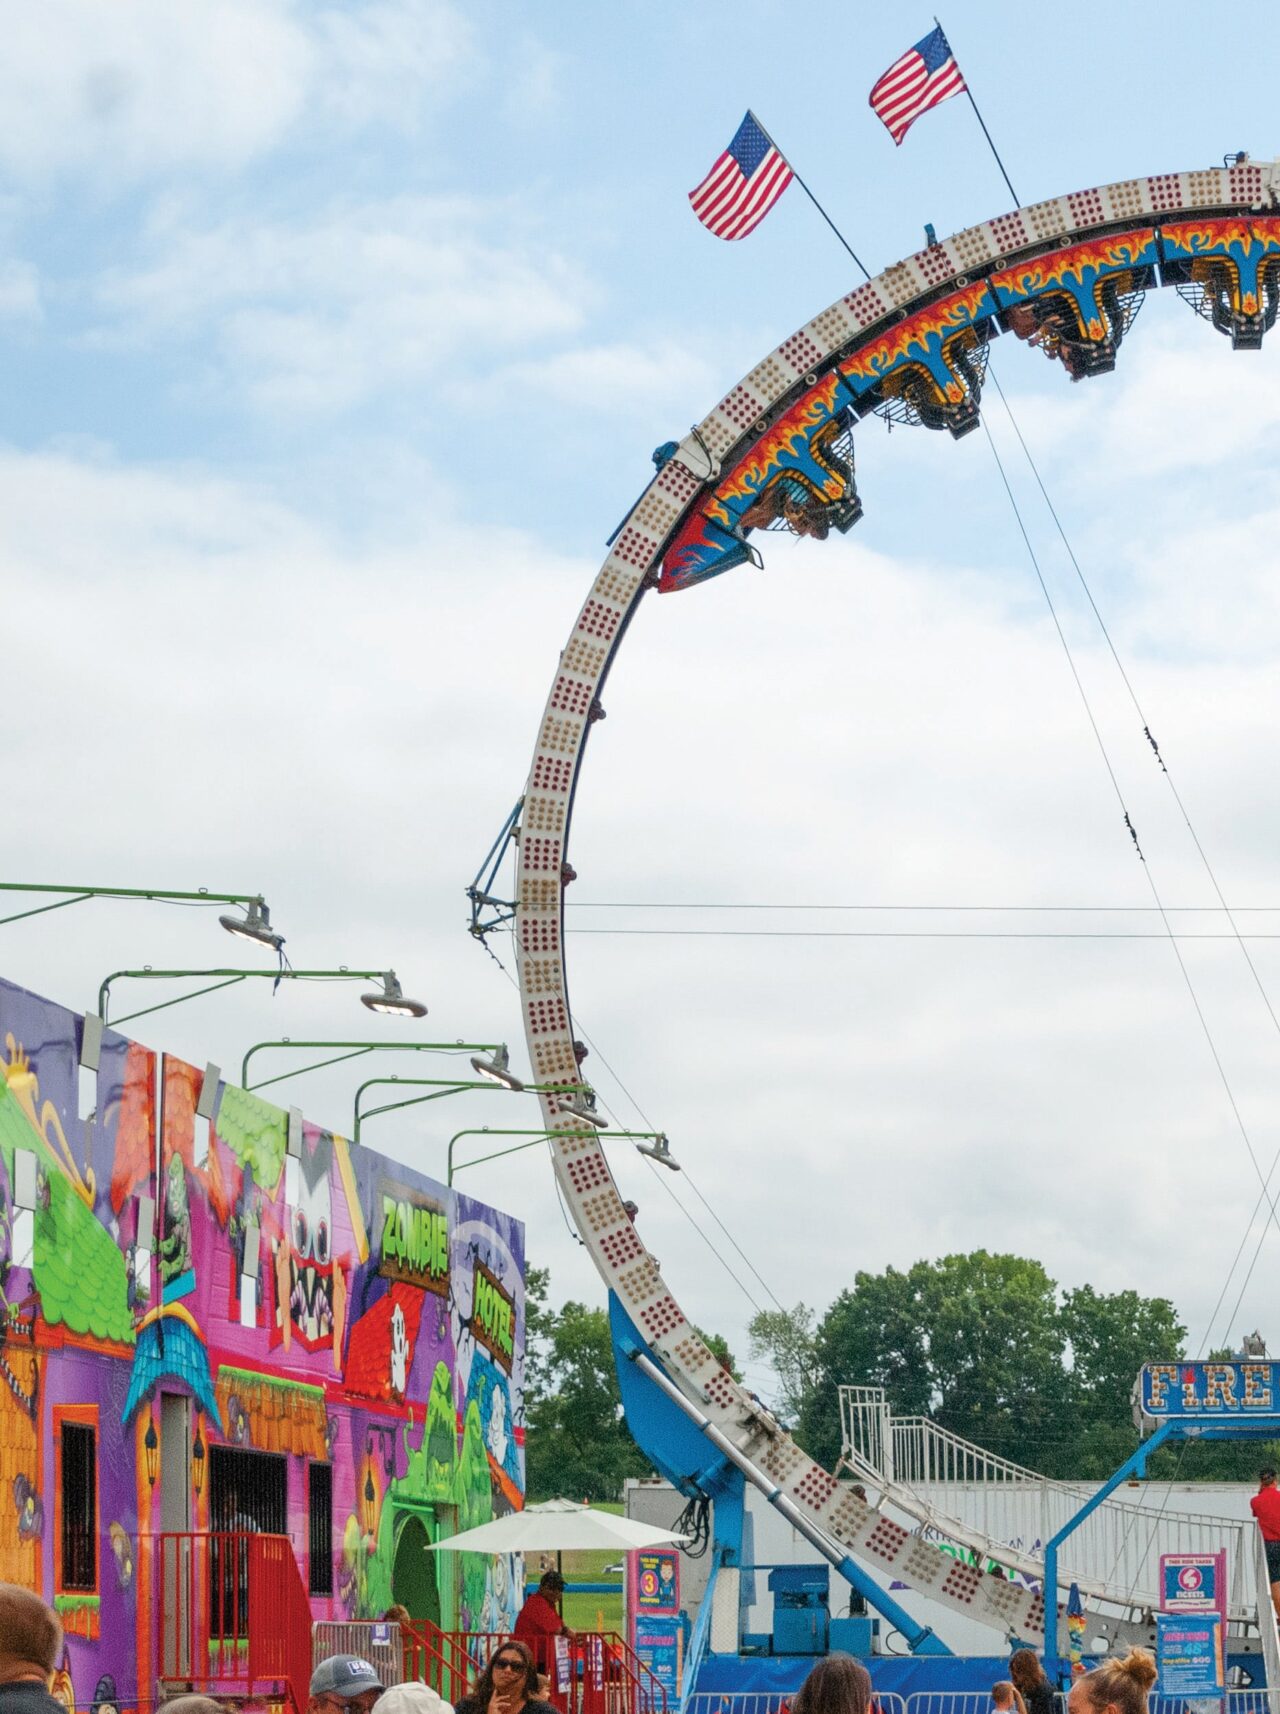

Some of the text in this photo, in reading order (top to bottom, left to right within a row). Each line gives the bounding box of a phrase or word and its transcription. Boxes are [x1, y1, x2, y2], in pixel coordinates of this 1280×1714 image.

[383, 1195, 448, 1279] ZOMBIE
[474, 1269, 514, 1357] HOTEL
[645, 1574, 654, 1593] 3
[1183, 1569, 1197, 1588] 4
[1176, 1591, 1205, 1599] TICKETS
